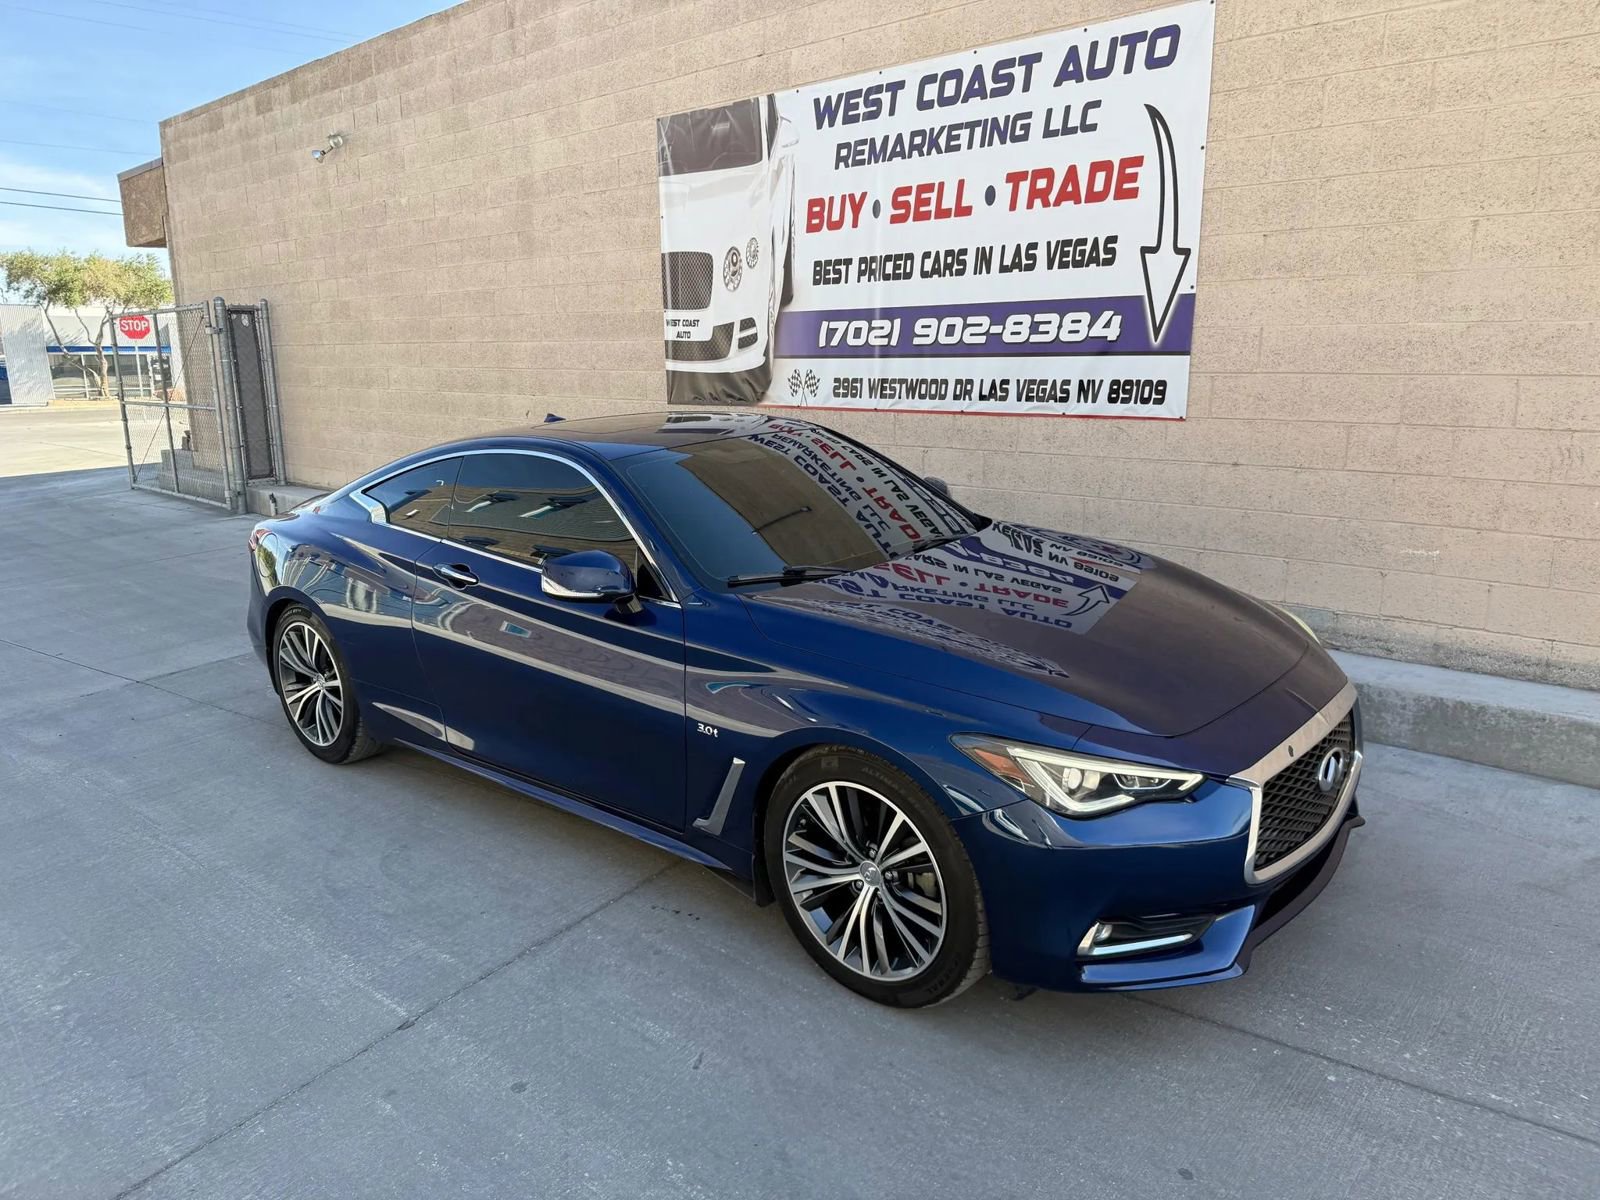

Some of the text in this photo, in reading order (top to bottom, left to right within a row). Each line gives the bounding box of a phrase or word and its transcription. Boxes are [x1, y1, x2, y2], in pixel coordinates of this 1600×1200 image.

[813, 23, 1181, 130] WEST COAST AUTO
[834, 99, 1102, 170] REMARKETING LLC
[806, 155, 1144, 233] BUY SELL TRADE
[812, 235, 1118, 286] BEST PRICED CARS IN LAS VEGAS
[120, 320, 149, 331] STOP
[666, 319, 700, 327] WEST COAST
[676, 331, 691, 339] AUTO
[913, 310, 1122, 345] 902-8384
[833, 377, 1167, 405] 2961 WESTWOOD DR LAS VEGAS NV 89109
